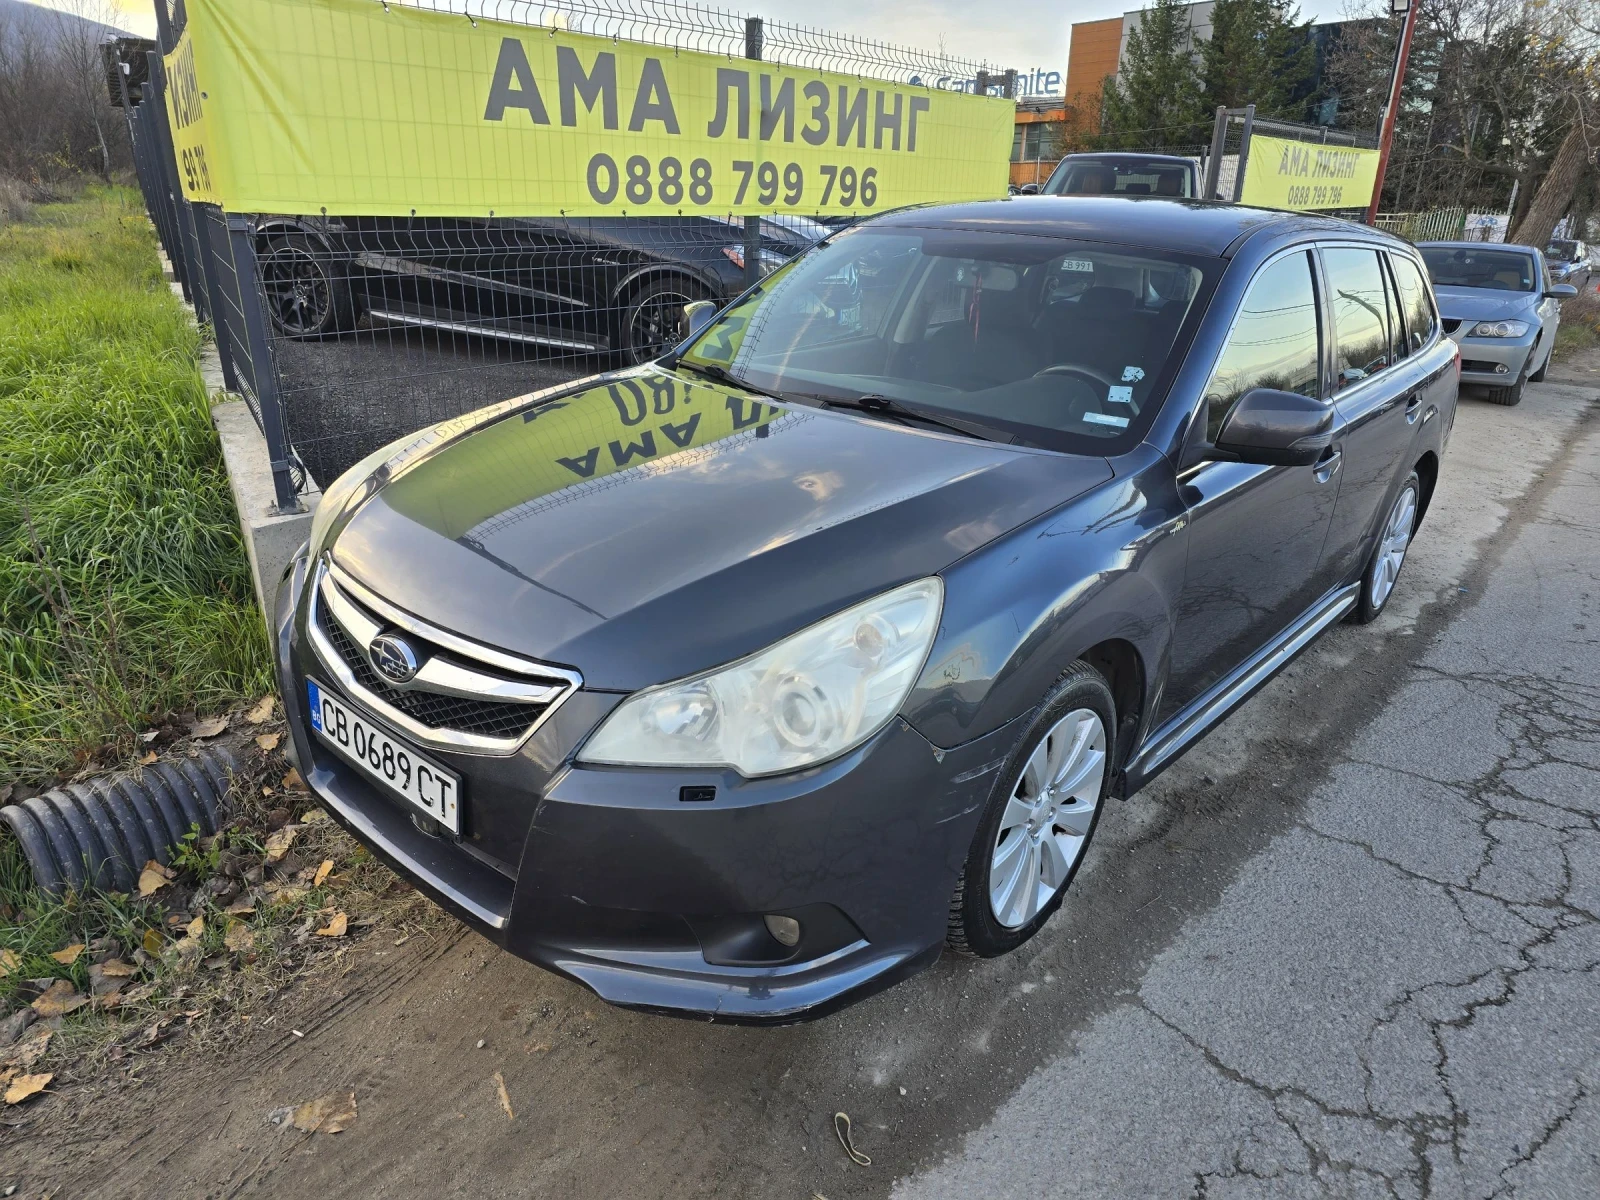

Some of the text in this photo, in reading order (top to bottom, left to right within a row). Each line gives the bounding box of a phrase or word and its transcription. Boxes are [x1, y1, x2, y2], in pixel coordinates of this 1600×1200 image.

[484, 37, 930, 152] АМА ЛИЗИНГ
[936, 68, 1061, 98] Sasnite
[1278, 145, 1360, 179] АМА ЛИЗИНГ
[586, 152, 878, 207] 0888 799 796
[1288, 185, 1343, 205] 0888 799 796
[1075, 261, 1091, 270] 991
[312, 710, 321, 725] BG
[322, 698, 452, 819] CB 0689 CT
